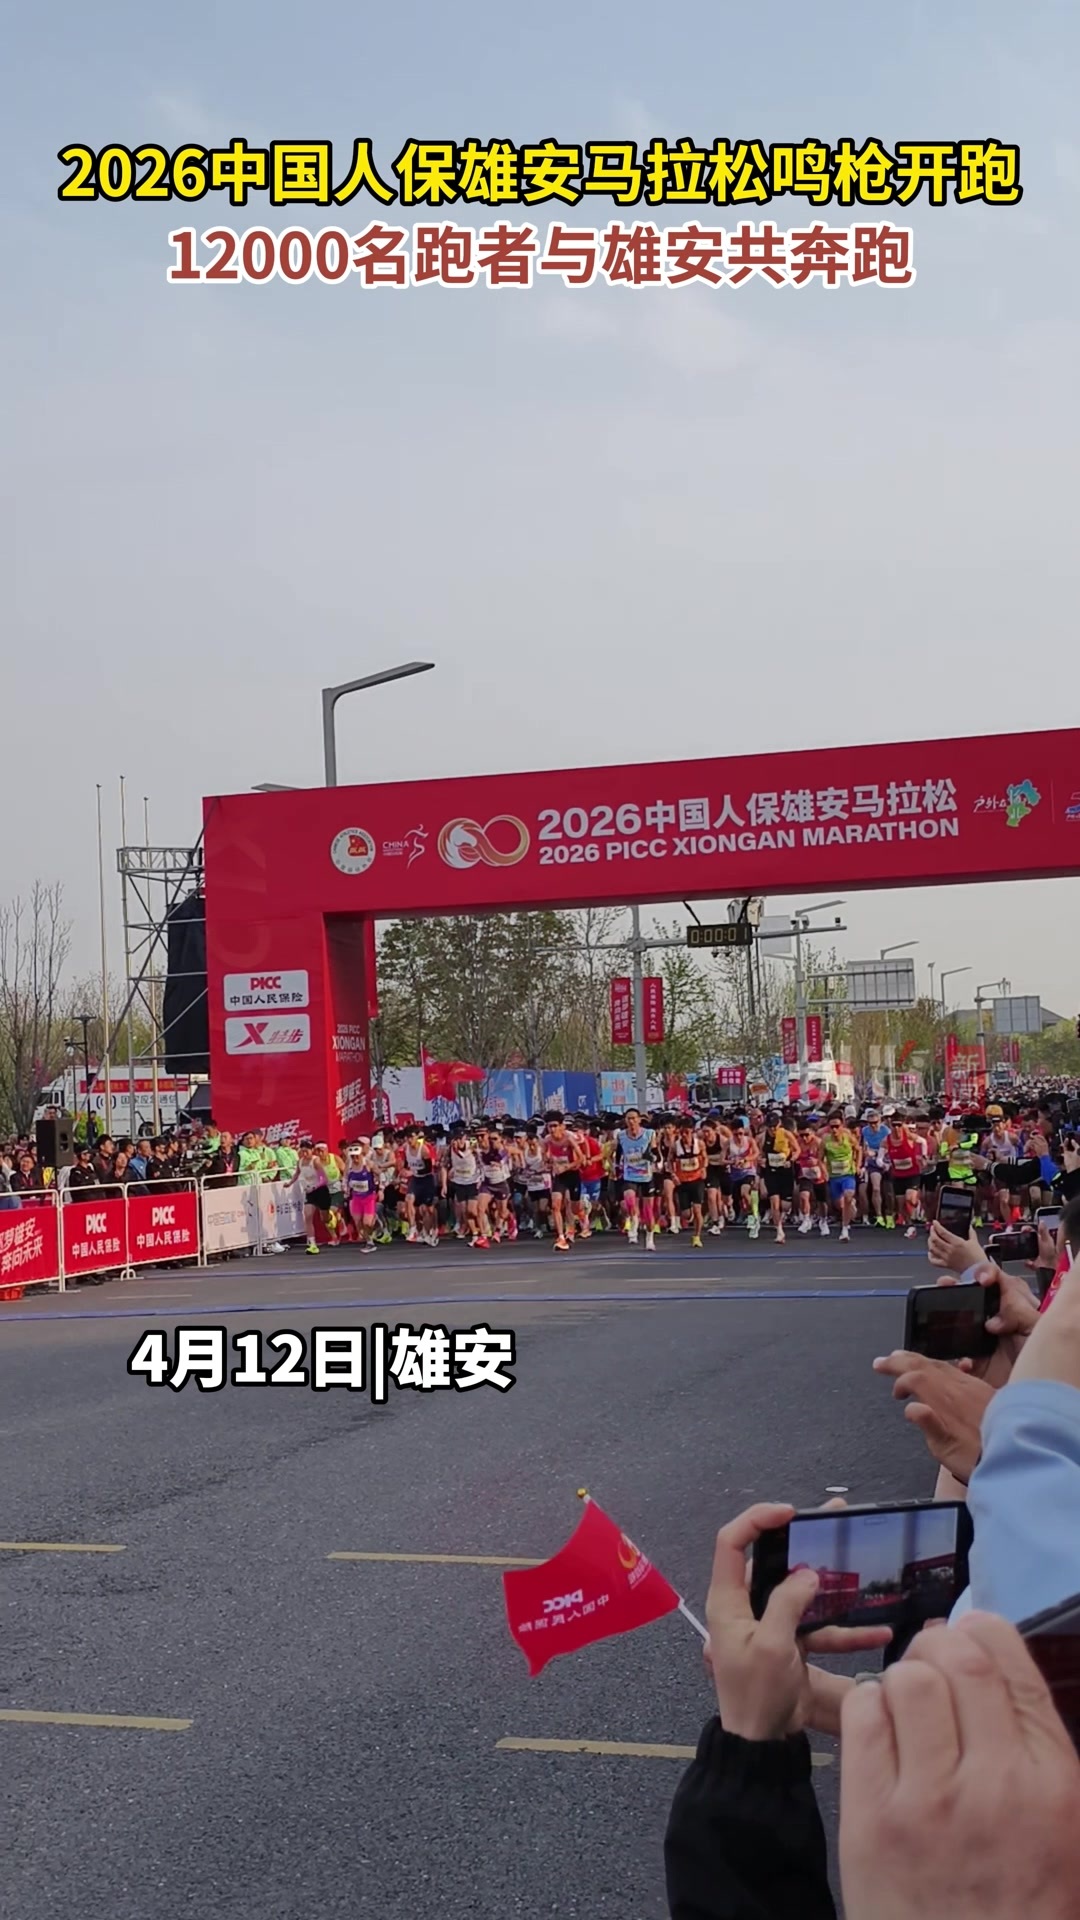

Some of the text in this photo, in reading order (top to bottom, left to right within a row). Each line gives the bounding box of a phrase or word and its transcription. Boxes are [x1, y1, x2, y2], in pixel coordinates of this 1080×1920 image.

[538, 778, 957, 841] 2026中国人保雄安马拉松
[382, 841, 410, 853] CHINA
[539, 817, 960, 866] 2026 PICC XIONGAN MARATHON
[250, 975, 282, 991] PICC
[229, 991, 304, 1007] 中国人民保险
[331, 1035, 366, 1051] XIONGAN
[85, 1212, 108, 1235] PICC
[152, 1205, 176, 1226] PICC
[71, 1237, 121, 1258] 中国人民保险
[136, 1228, 191, 1250] 中国人民保险
[1, 1235, 44, 1276] 奔向未来
